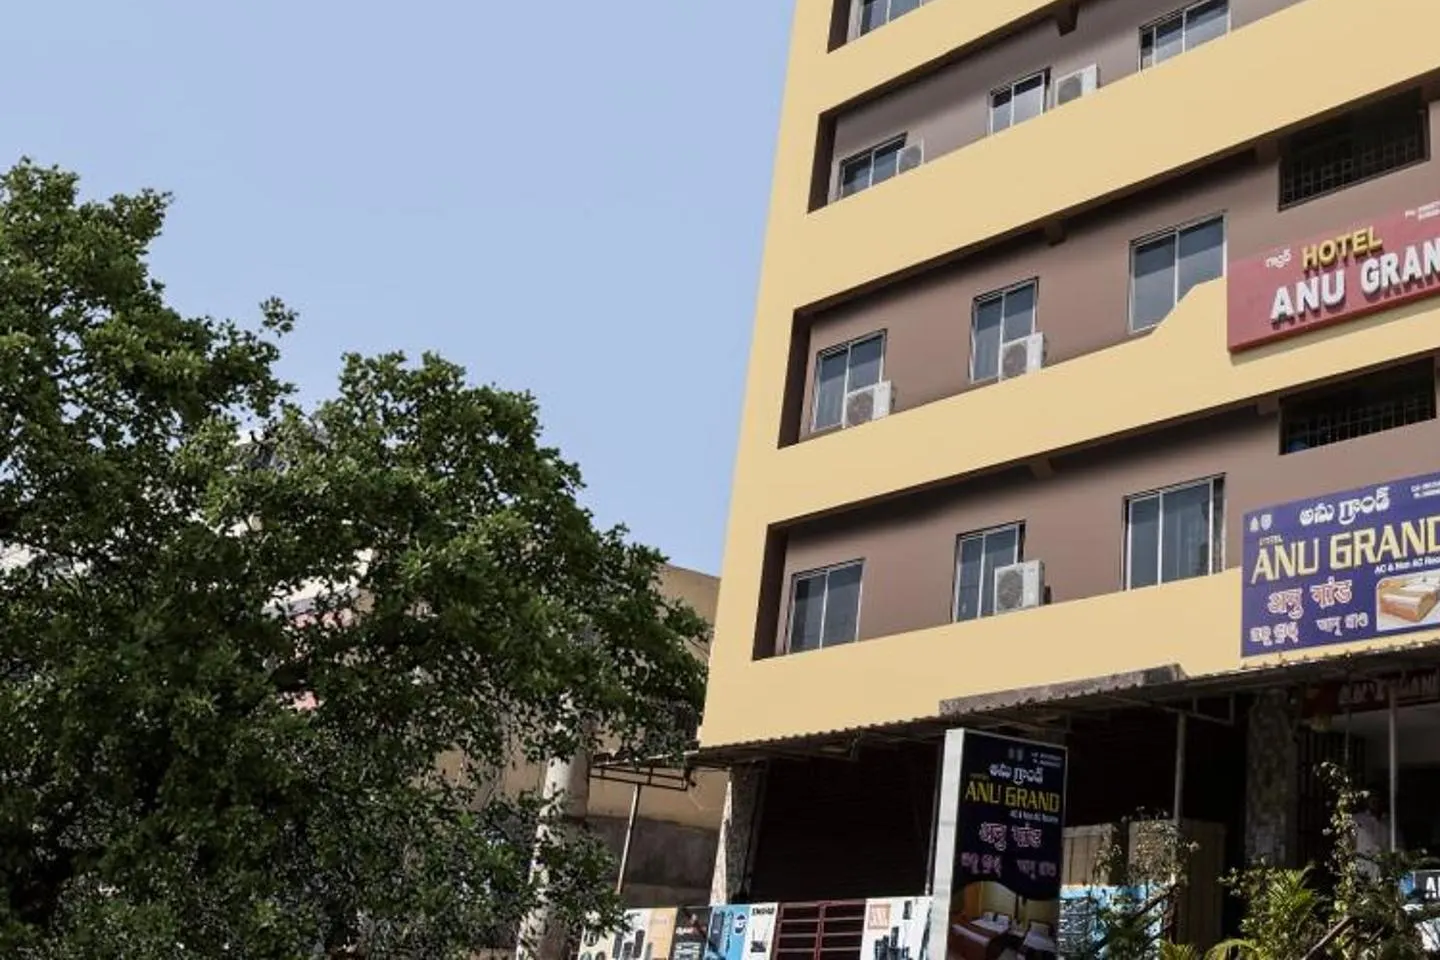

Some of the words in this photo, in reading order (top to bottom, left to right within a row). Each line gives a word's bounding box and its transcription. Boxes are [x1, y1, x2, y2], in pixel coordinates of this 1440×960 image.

[1302, 226, 1383, 269] HOTEL
[1270, 269, 1345, 320] ANU
[1251, 538, 1320, 585] ANU
[965, 781, 1001, 805] ANU
[1005, 786, 1061, 813] GRAND
